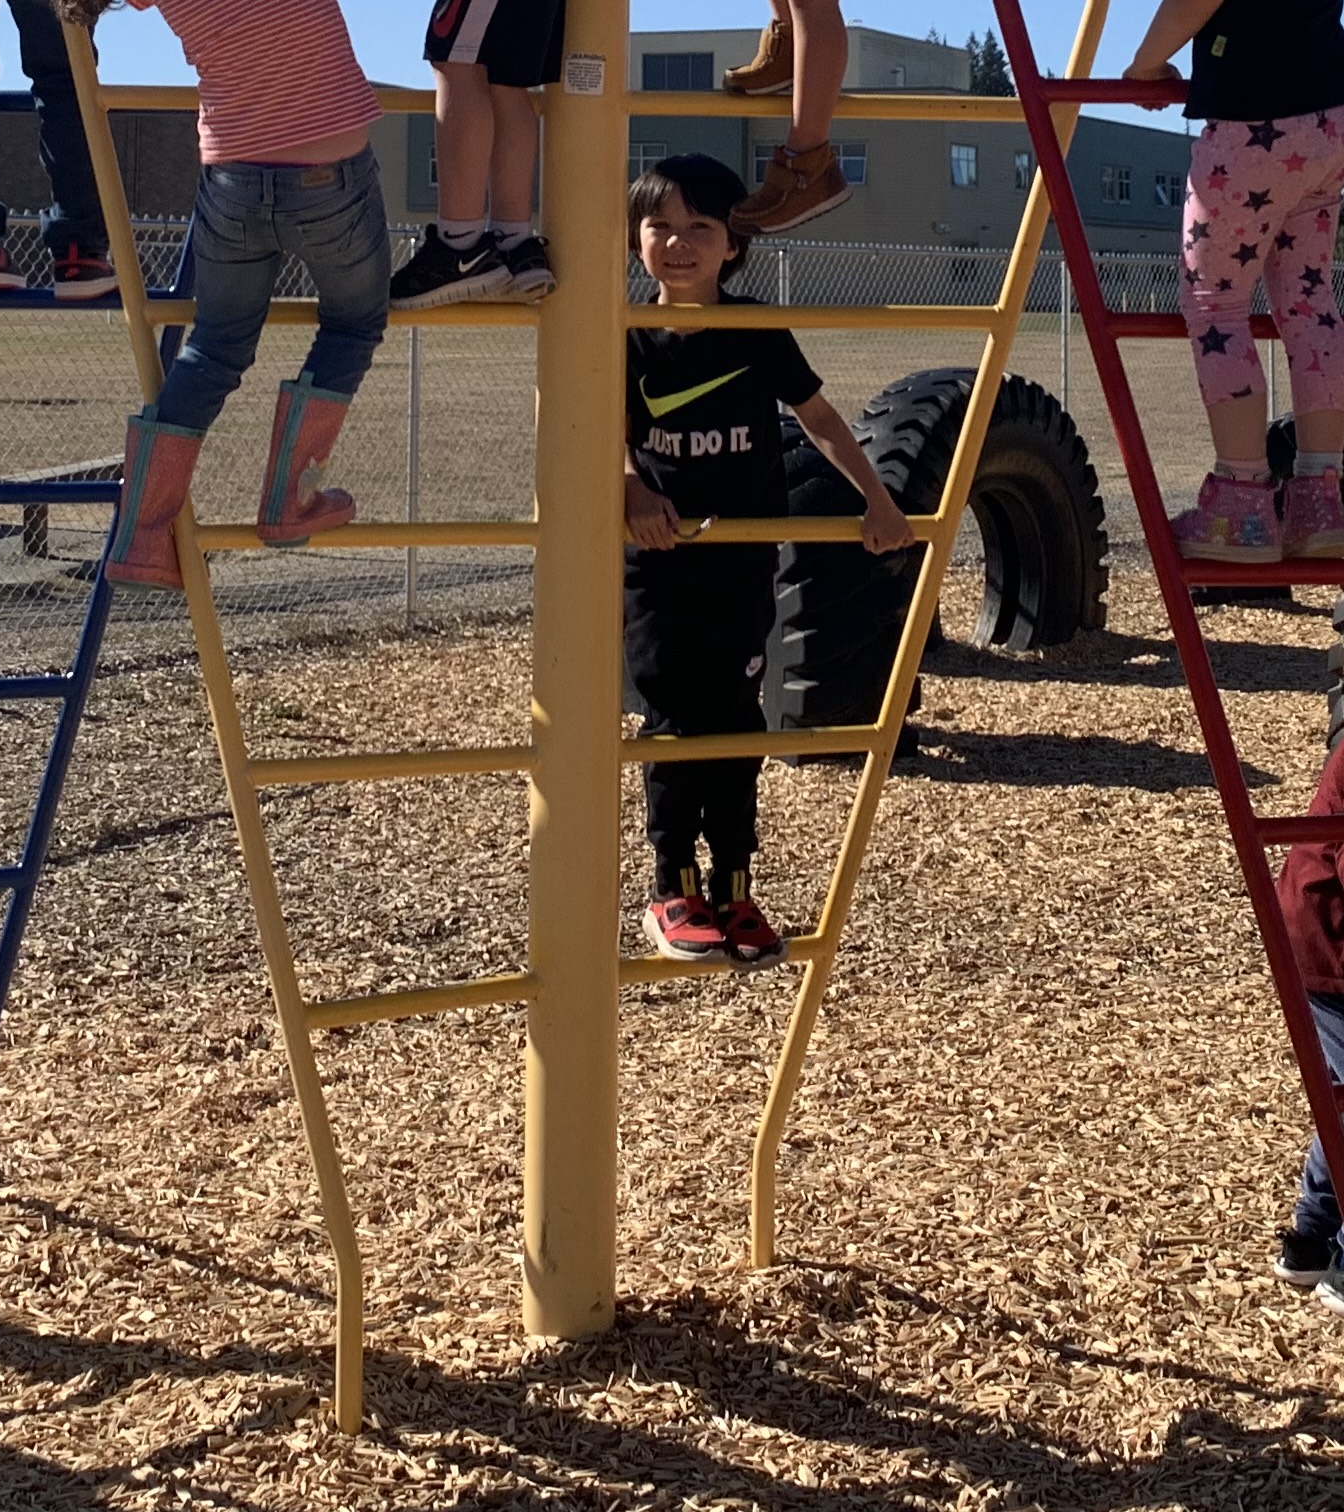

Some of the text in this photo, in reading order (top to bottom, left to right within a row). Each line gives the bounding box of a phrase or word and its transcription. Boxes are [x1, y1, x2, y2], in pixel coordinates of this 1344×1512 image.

[642, 426, 752, 458] JUST DO IT.
